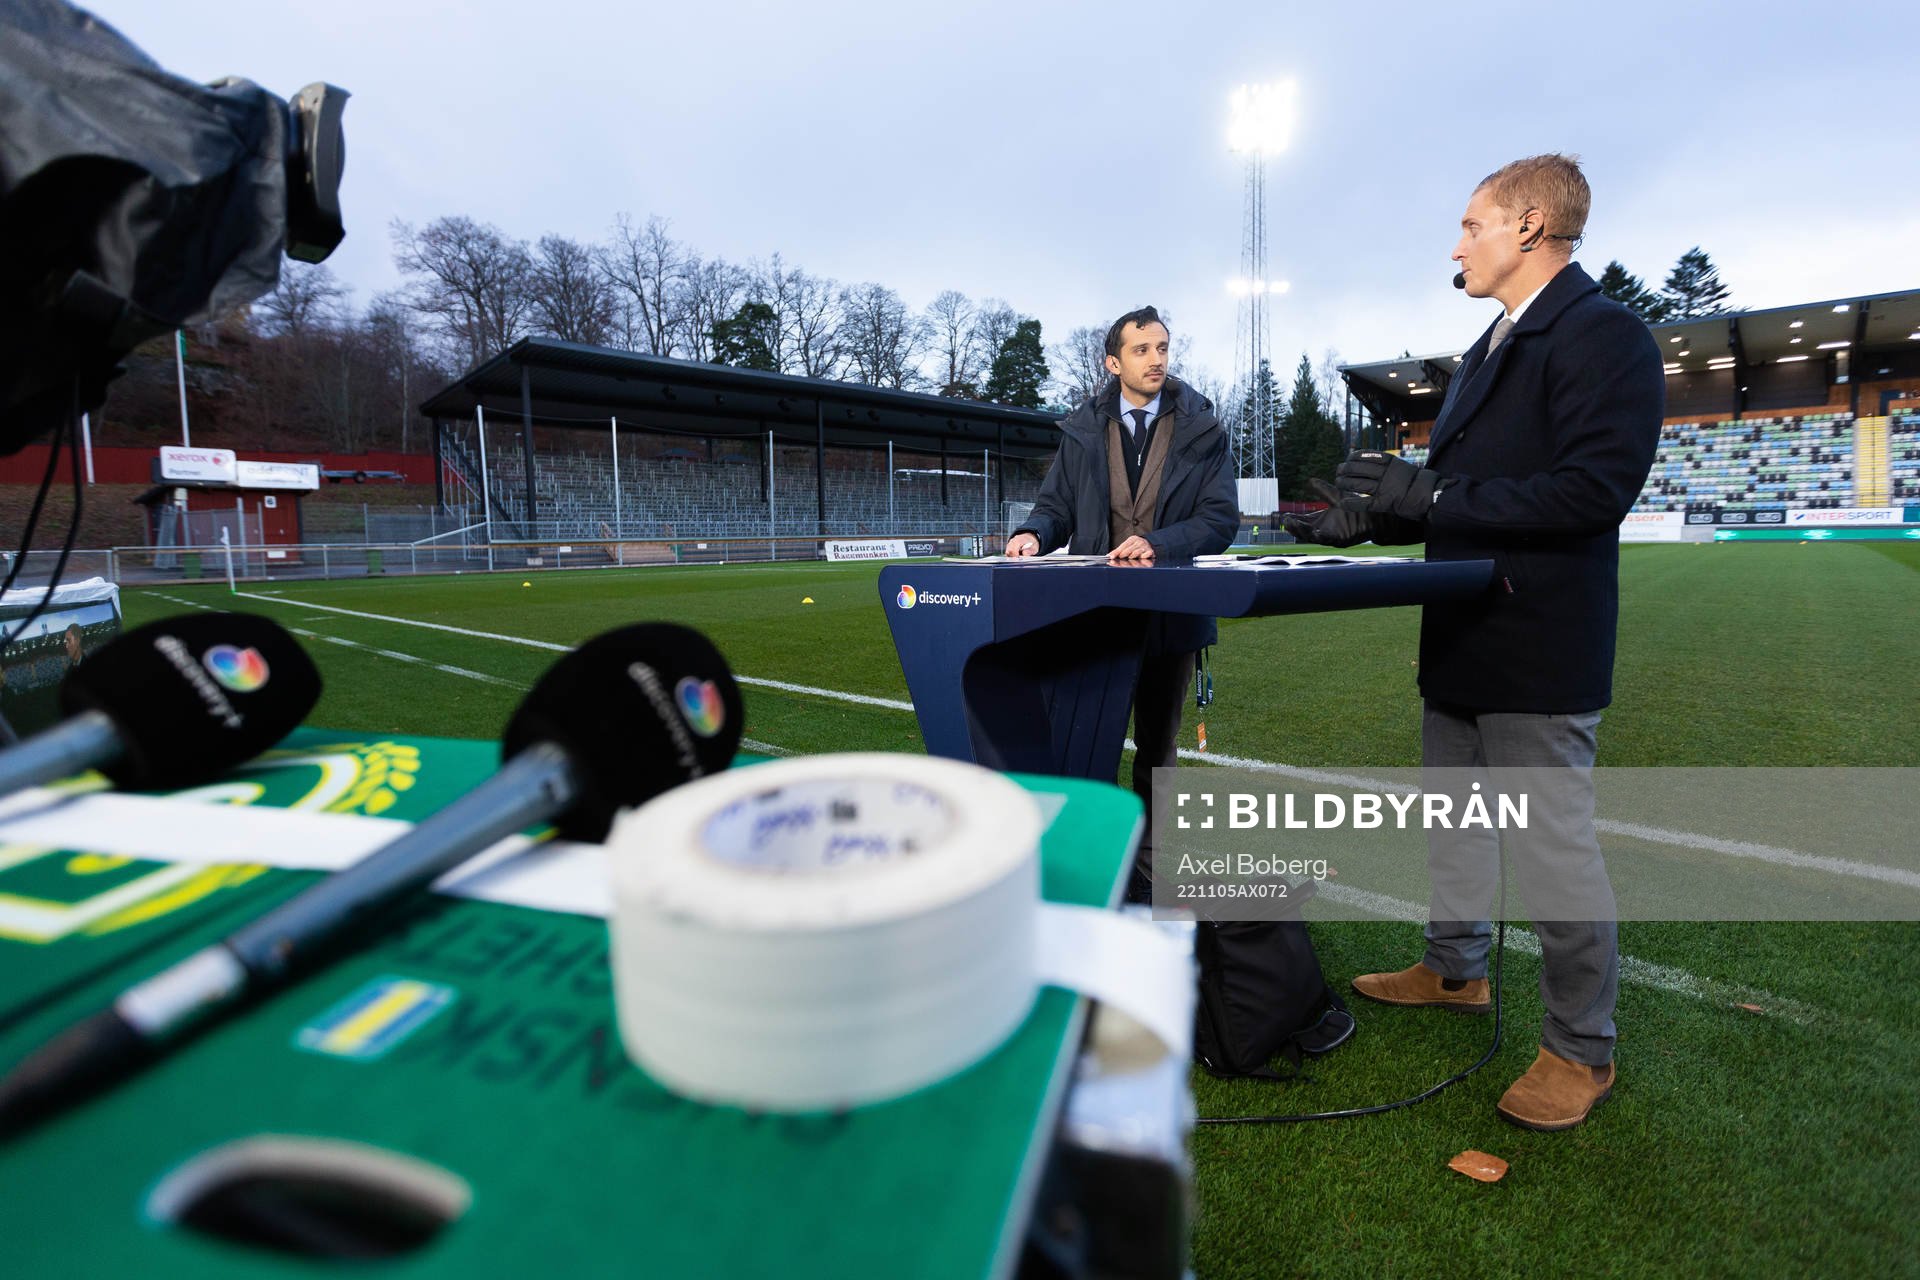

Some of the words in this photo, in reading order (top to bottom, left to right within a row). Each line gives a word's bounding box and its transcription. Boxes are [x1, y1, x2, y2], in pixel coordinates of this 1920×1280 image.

[1805, 511, 1892, 521] INTERSPORT
[833, 543, 887, 553] Restaurang
[918, 591, 982, 608] discovery+
